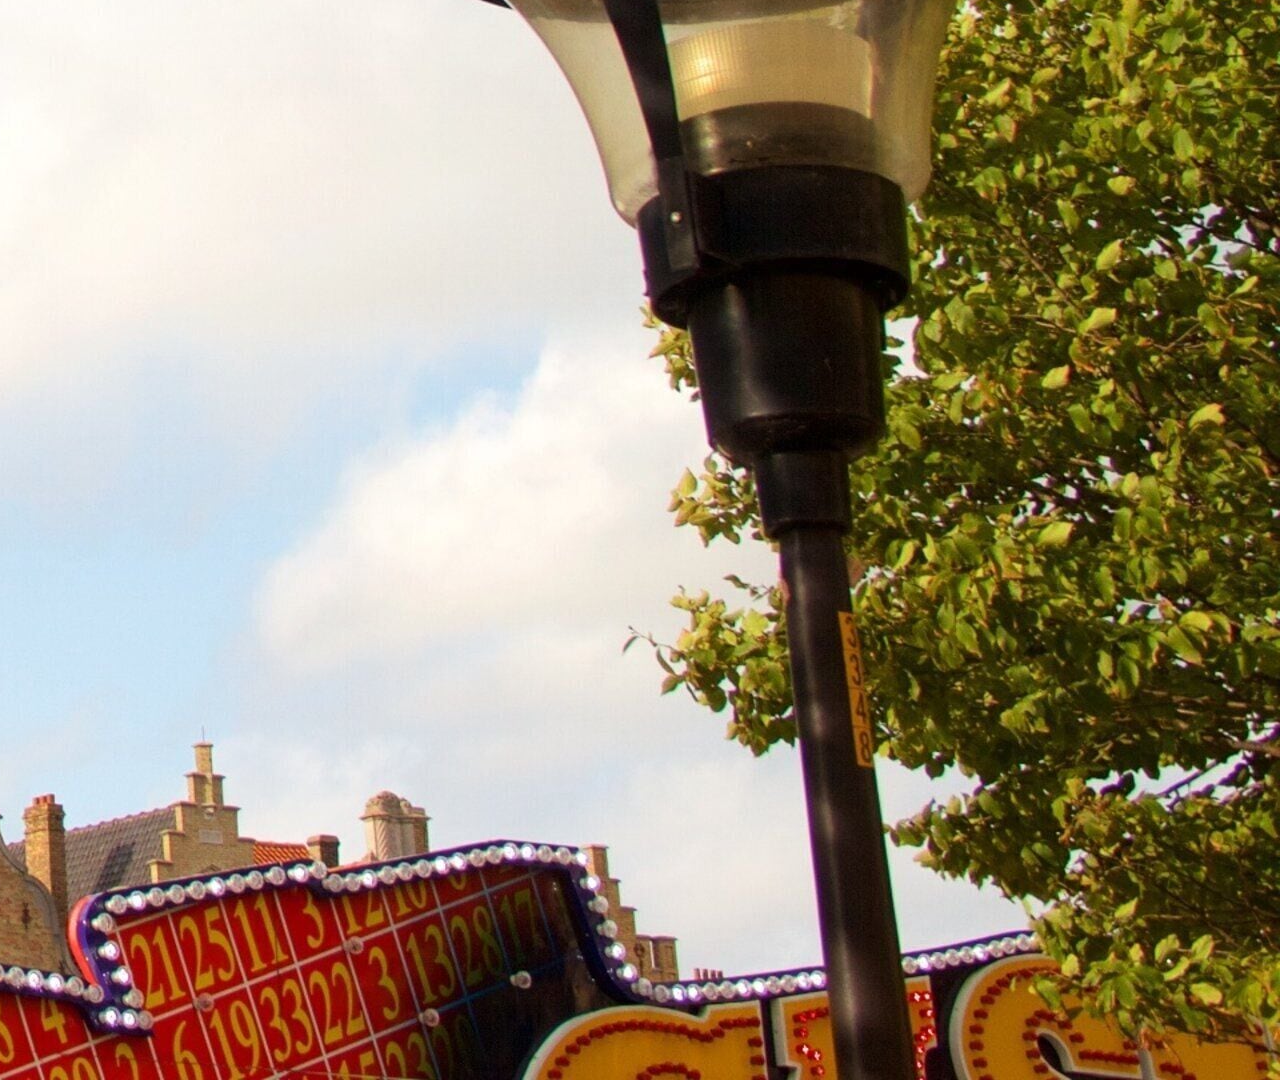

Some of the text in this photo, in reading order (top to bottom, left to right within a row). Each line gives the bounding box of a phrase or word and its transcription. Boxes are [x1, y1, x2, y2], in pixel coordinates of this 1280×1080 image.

[130, 926, 186, 1009] 21
[179, 906, 235, 990] 25
[234, 894, 289, 971] 11
[173, 1021, 204, 1080] 6
[210, 1000, 260, 1080] 19
[260, 978, 314, 1062] 33
[309, 962, 366, 1044] 22
[368, 946, 400, 1019] 3
[406, 924, 455, 1004] 13
[450, 905, 505, 987] 28
[500, 888, 542, 963] 17
